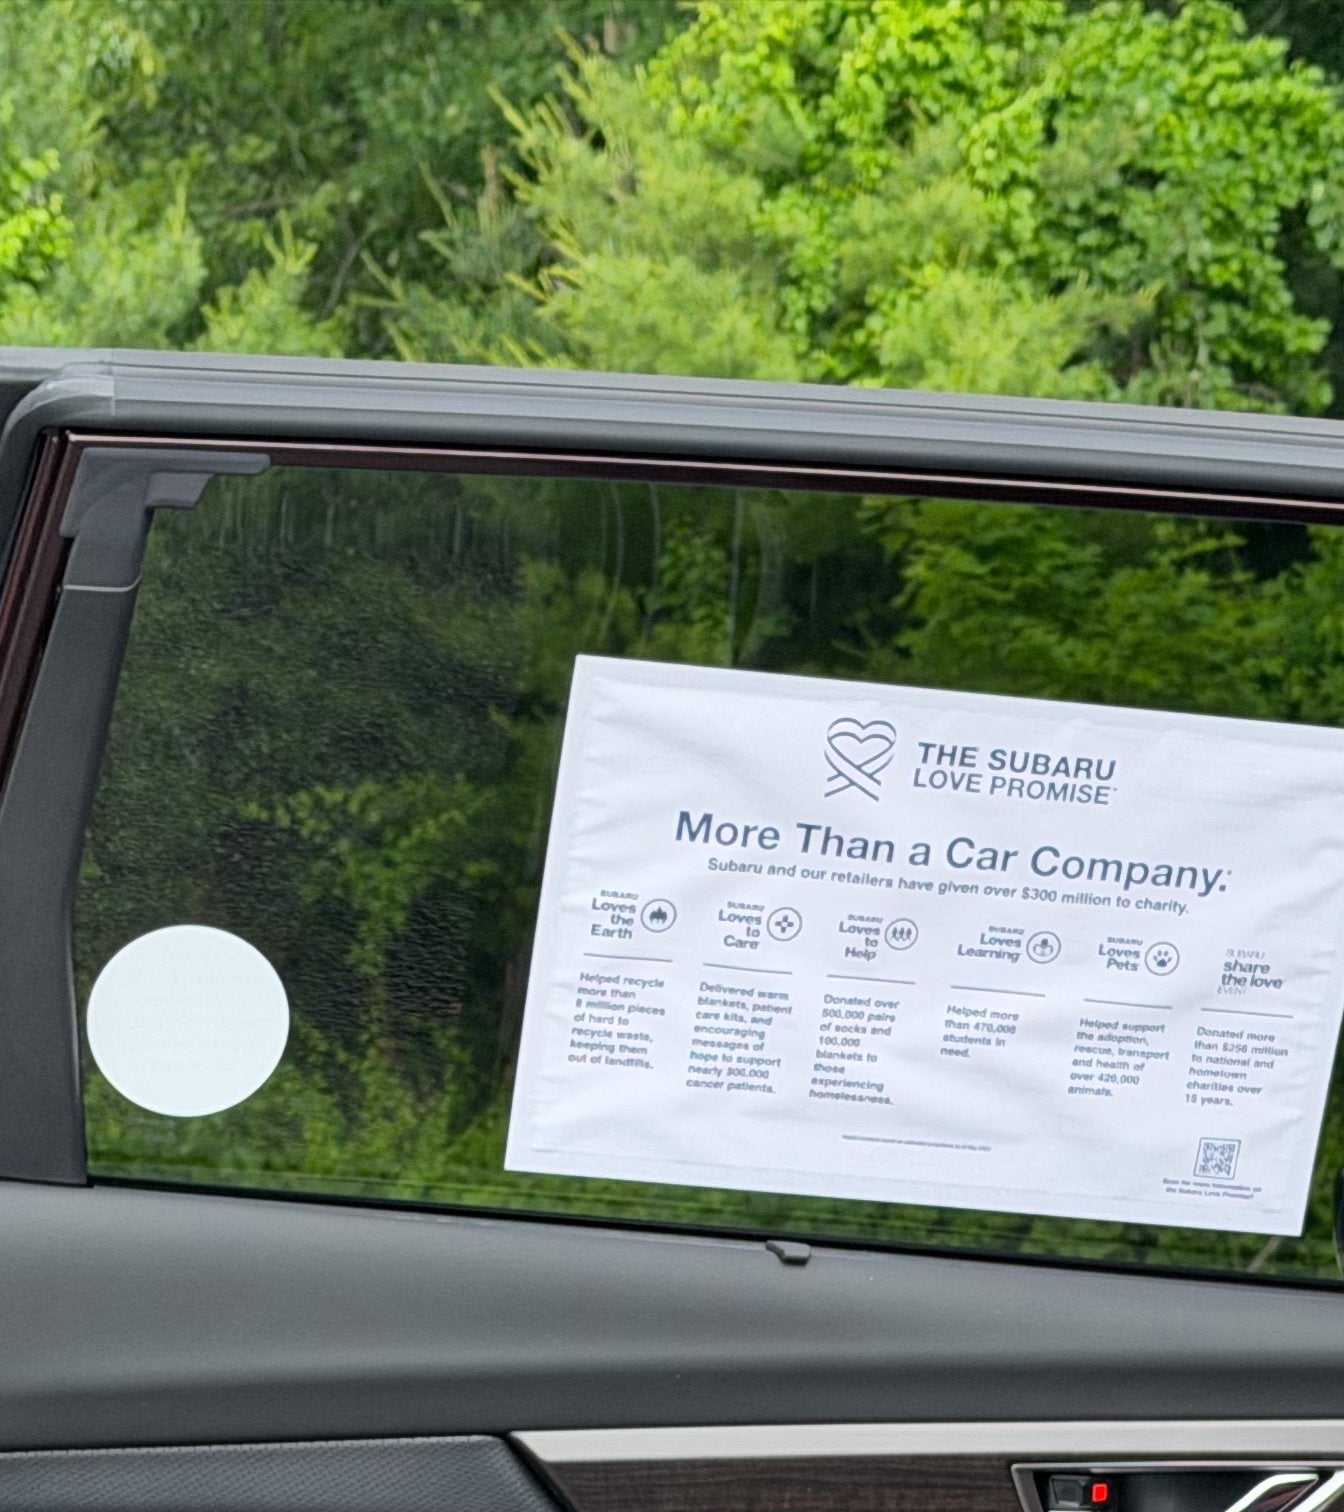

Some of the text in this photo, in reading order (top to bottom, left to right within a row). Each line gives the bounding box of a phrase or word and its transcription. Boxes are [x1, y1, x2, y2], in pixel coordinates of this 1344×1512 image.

[918, 742, 1116, 780] THE SUBARU
[913, 768, 1111, 805] LOVE PROMISE
[675, 811, 780, 850] More
[796, 823, 895, 863] Than
[908, 842, 931, 866] a
[946, 837, 1018, 872] Car
[708, 857, 1189, 916] Subaru and our retailers have given over $300 million to charity.
[592, 897, 636, 914] Loves
[610, 914, 634, 926] the
[718, 909, 762, 925] Loves
[591, 923, 632, 939] Earth
[746, 926, 760, 937] to
[839, 921, 880, 936] Loves
[724, 935, 760, 949] Care
[865, 937, 878, 947] to
[980, 933, 1021, 947] Loves
[845, 947, 876, 961] Help
[957, 944, 1021, 963] Learning
[1098, 944, 1140, 959] Loves
[1106, 958, 1139, 972] Pets
[1224, 960, 1270, 974] share
[580, 972, 664, 988] Helped recycle
[1221, 973, 1283, 989] the love
[577, 986, 636, 999] more than
[699, 982, 789, 1000] Delivered warm
[586, 1000, 624, 1011] million
[628, 1004, 665, 1016] pieces
[697, 996, 793, 1015] blankets, patient
[824, 994, 900, 1009] Donated over
[574, 1013, 629, 1026] of hard to
[696, 1011, 773, 1026] care kits, and
[822, 1008, 896, 1023] 500,000 pairs
[946, 1005, 1019, 1021] Helped more
[820, 1022, 892, 1036] of socks and
[944, 1019, 969, 1030] than
[1080, 1018, 1166, 1033] Helped support
[571, 1026, 612, 1039] recycle
[694, 1025, 765, 1040] encouraging
[1077, 1031, 1149, 1046] the adoption,
[1196, 1026, 1275, 1043] Donated more
[570, 1039, 647, 1055] keeping them
[692, 1038, 764, 1051] messages of
[819, 1037, 860, 1047] 100,000
[942, 1034, 1006, 1047] students in
[816, 1049, 877, 1063] blankets to
[940, 1047, 970, 1058] need.
[1074, 1045, 1170, 1061] rescue, transport
[1194, 1040, 1219, 1052] than
[1251, 1045, 1288, 1057] million
[568, 1054, 654, 1069] out of landfills.
[690, 1050, 781, 1067] hope to support
[1072, 1058, 1145, 1071] and health of
[1192, 1053, 1274, 1070] to national and
[688, 1064, 723, 1077] nearly
[814, 1063, 845, 1073] those
[1189, 1067, 1246, 1080] hometown
[811, 1077, 884, 1093] experiencing
[1070, 1072, 1139, 1085] over 420,000
[686, 1079, 776, 1094] cancer patients.
[1068, 1085, 1113, 1097] animals.
[1186, 1080, 1263, 1095] charities over
[809, 1089, 894, 1105] homelessness.
[1201, 1096, 1234, 1107] years.
